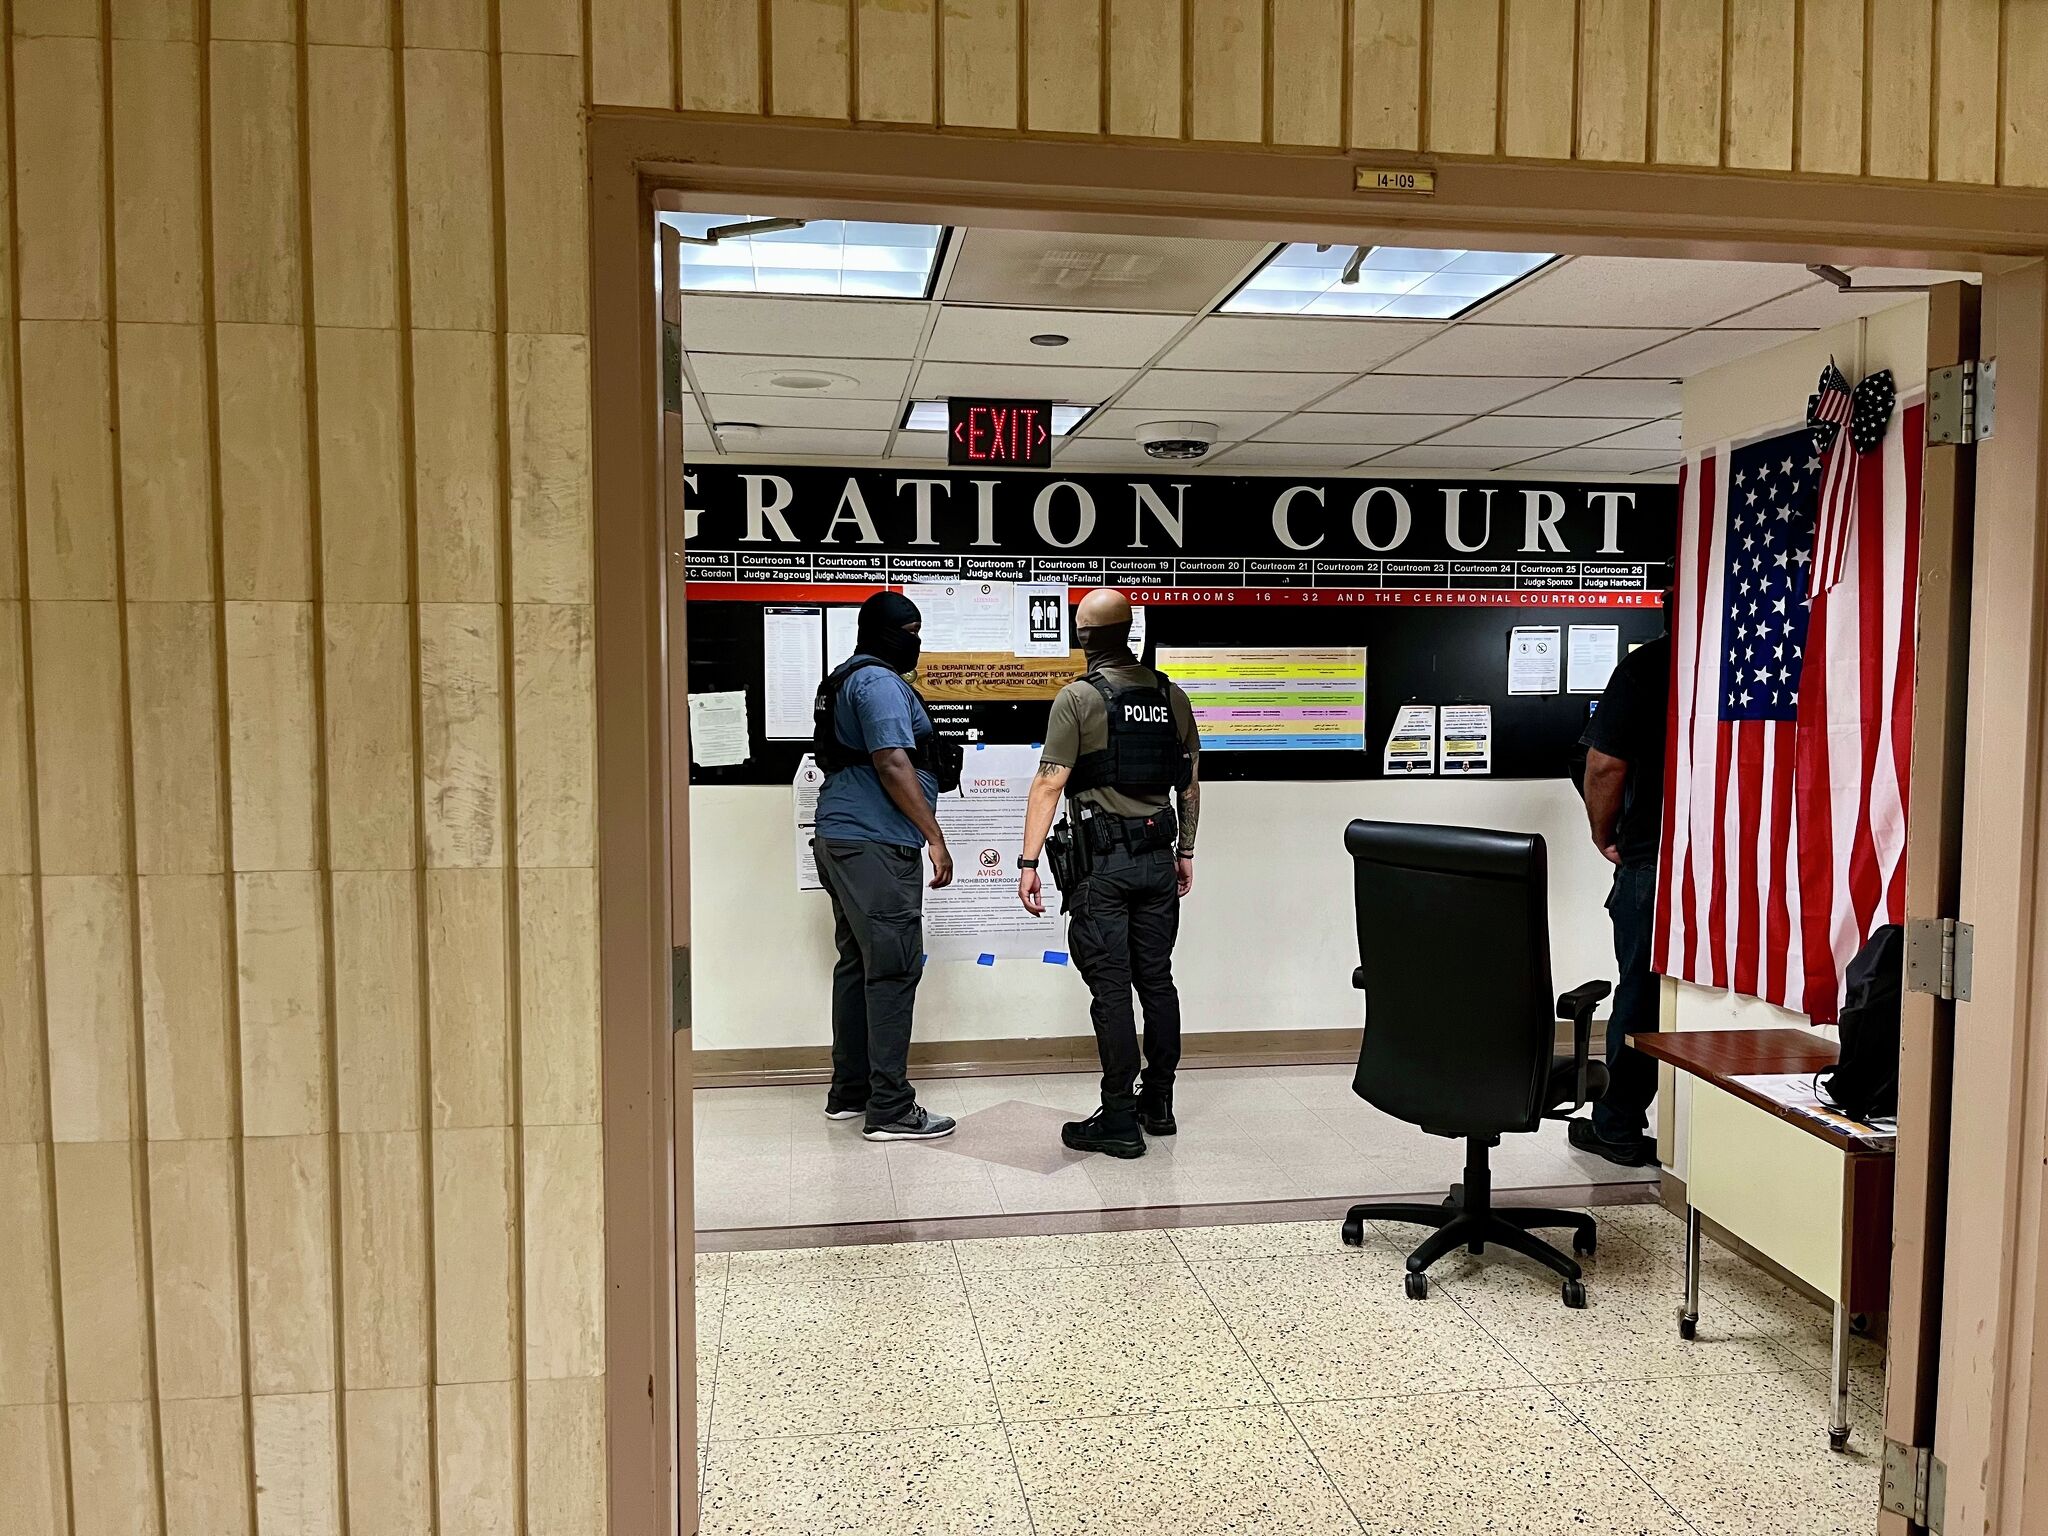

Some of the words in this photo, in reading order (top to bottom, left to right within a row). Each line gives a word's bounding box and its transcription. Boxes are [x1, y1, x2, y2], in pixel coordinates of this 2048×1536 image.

[1377, 173, 1415, 188] 14-109
[969, 407, 1039, 460] EXIT
[1271, 485, 1637, 554] COURT
[719, 555, 729, 564] 13
[742, 555, 792, 565] Courtroom
[795, 556, 805, 565] 14
[818, 557, 867, 566] Courtroom
[870, 558, 881, 567] 15
[893, 558, 941, 567] Courtroom
[943, 559, 954, 567] 16
[966, 559, 1014, 568] Courtroom
[1017, 560, 1026, 569] 17
[1038, 560, 1085, 569] Courtroom
[1088, 561, 1098, 569] 18
[1110, 561, 1156, 569] Courtroom
[1159, 561, 1169, 570] 19
[1179, 562, 1225, 570] Courtroom
[1228, 562, 1240, 570] 20
[1250, 562, 1295, 570] Courtroom
[1298, 563, 1308, 571] 21
[1317, 563, 1364, 571] Courtroom
[1367, 564, 1379, 572] 22
[1387, 564, 1431, 572] Courtroom
[1433, 564, 1444, 572] 23
[1454, 564, 1498, 572] Courtroom
[1500, 565, 1511, 573] 24
[1520, 565, 1563, 573] Courtroom
[1566, 565, 1577, 573] 25
[690, 569, 699, 577] C.
[701, 569, 732, 578] Gordon
[966, 569, 993, 578] Judge
[995, 569, 1024, 579] Kouris
[1584, 566, 1629, 574] Courtroom
[1631, 566, 1643, 574] 26
[743, 570, 771, 580] Judge
[773, 571, 811, 581] Zagzoug
[814, 570, 834, 581] Judge
[890, 572, 912, 582] Judge
[1037, 574, 1061, 583] Judge
[1062, 574, 1101, 583] McFarland
[1117, 575, 1140, 585] Judge
[1142, 575, 1162, 583] Khan
[1523, 578, 1546, 587] Judge
[1584, 579, 1608, 588] Judge
[1610, 579, 1641, 587] Harbeck
[1130, 592, 1235, 601] COURTROOMS
[1256, 593, 1271, 601] 16
[1302, 593, 1319, 601] 32
[1337, 594, 1365, 602] AND
[1375, 594, 1401, 602] THE
[1413, 594, 1512, 603] CEREMONIAL
[1520, 594, 1608, 603] COURTROOM
[1617, 596, 1642, 604] ARE
[1124, 705, 1169, 723] POLICE
[974, 779, 1006, 787] NOTICE
[976, 869, 1003, 877] AVISO
